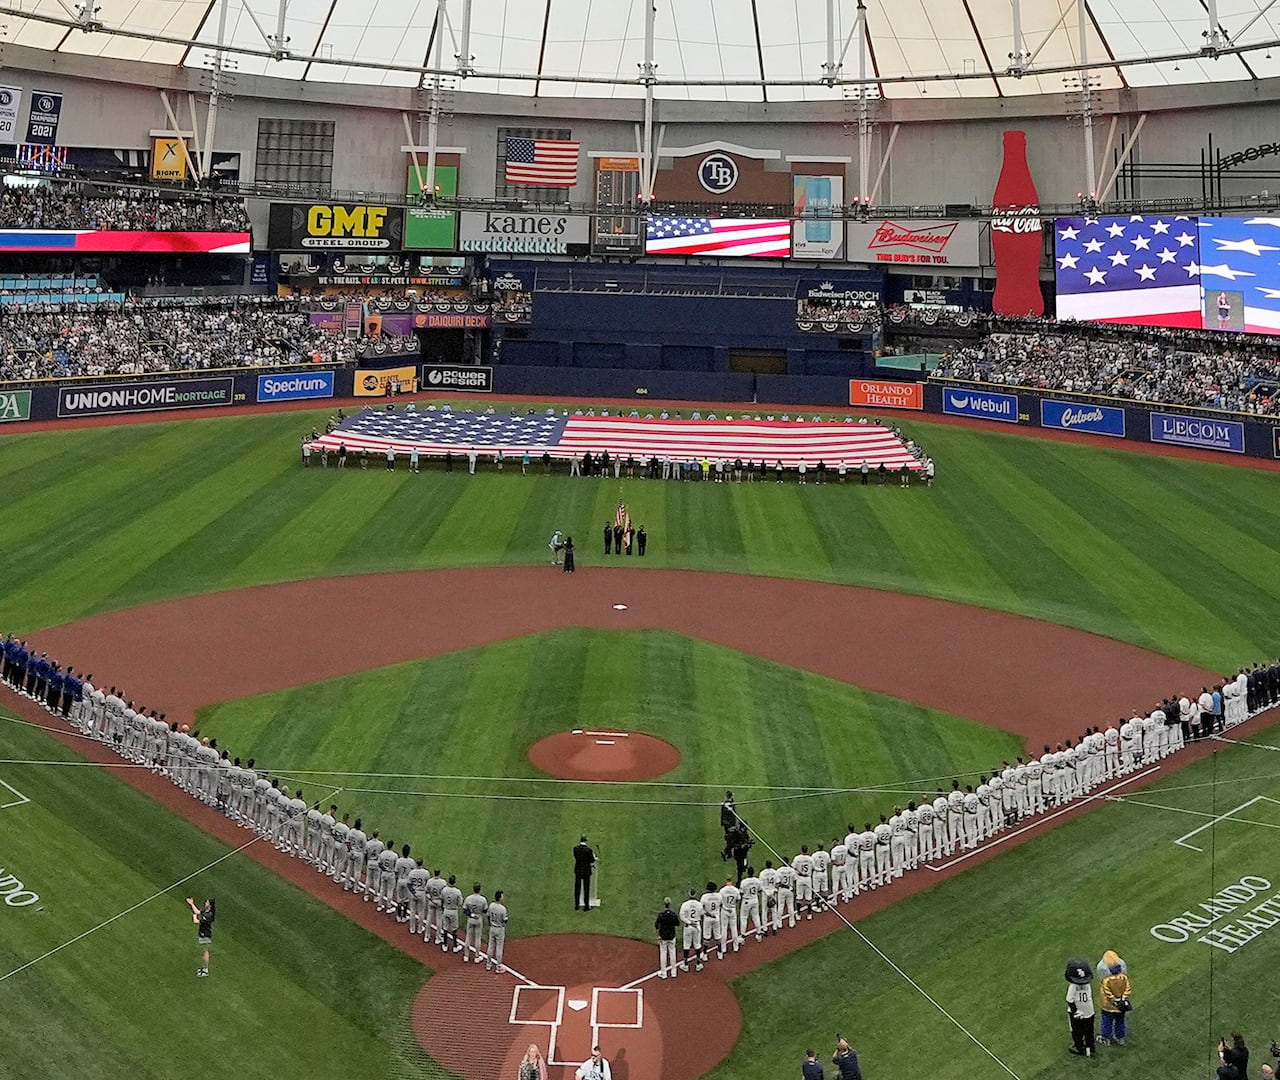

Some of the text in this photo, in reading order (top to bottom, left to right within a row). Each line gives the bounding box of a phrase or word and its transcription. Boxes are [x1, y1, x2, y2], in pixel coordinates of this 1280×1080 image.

[30, 114, 58, 123] CHAMPIONS
[32, 125, 53, 137] 2021
[307, 205, 388, 237] GMF
[483, 216, 567, 235] kanes
[875, 228, 950, 243] Budweiser
[917, 254, 930, 262] FOR
[494, 281, 522, 290] PORCH
[808, 290, 879, 300] Budweiser PORCH
[429, 315, 487, 328] DAIQUIRI DECK
[264, 379, 322, 395] Spectrum
[860, 383, 913, 395] ORLANDO
[867, 394, 907, 405] HEALTH
[970, 397, 1010, 414] Webull
[1060, 408, 1103, 427] Culver's
[1162, 420, 1230, 440] LECOM
[1150, 876, 1272, 943] ORLANDO
[1079, 992, 1088, 1003] 10
